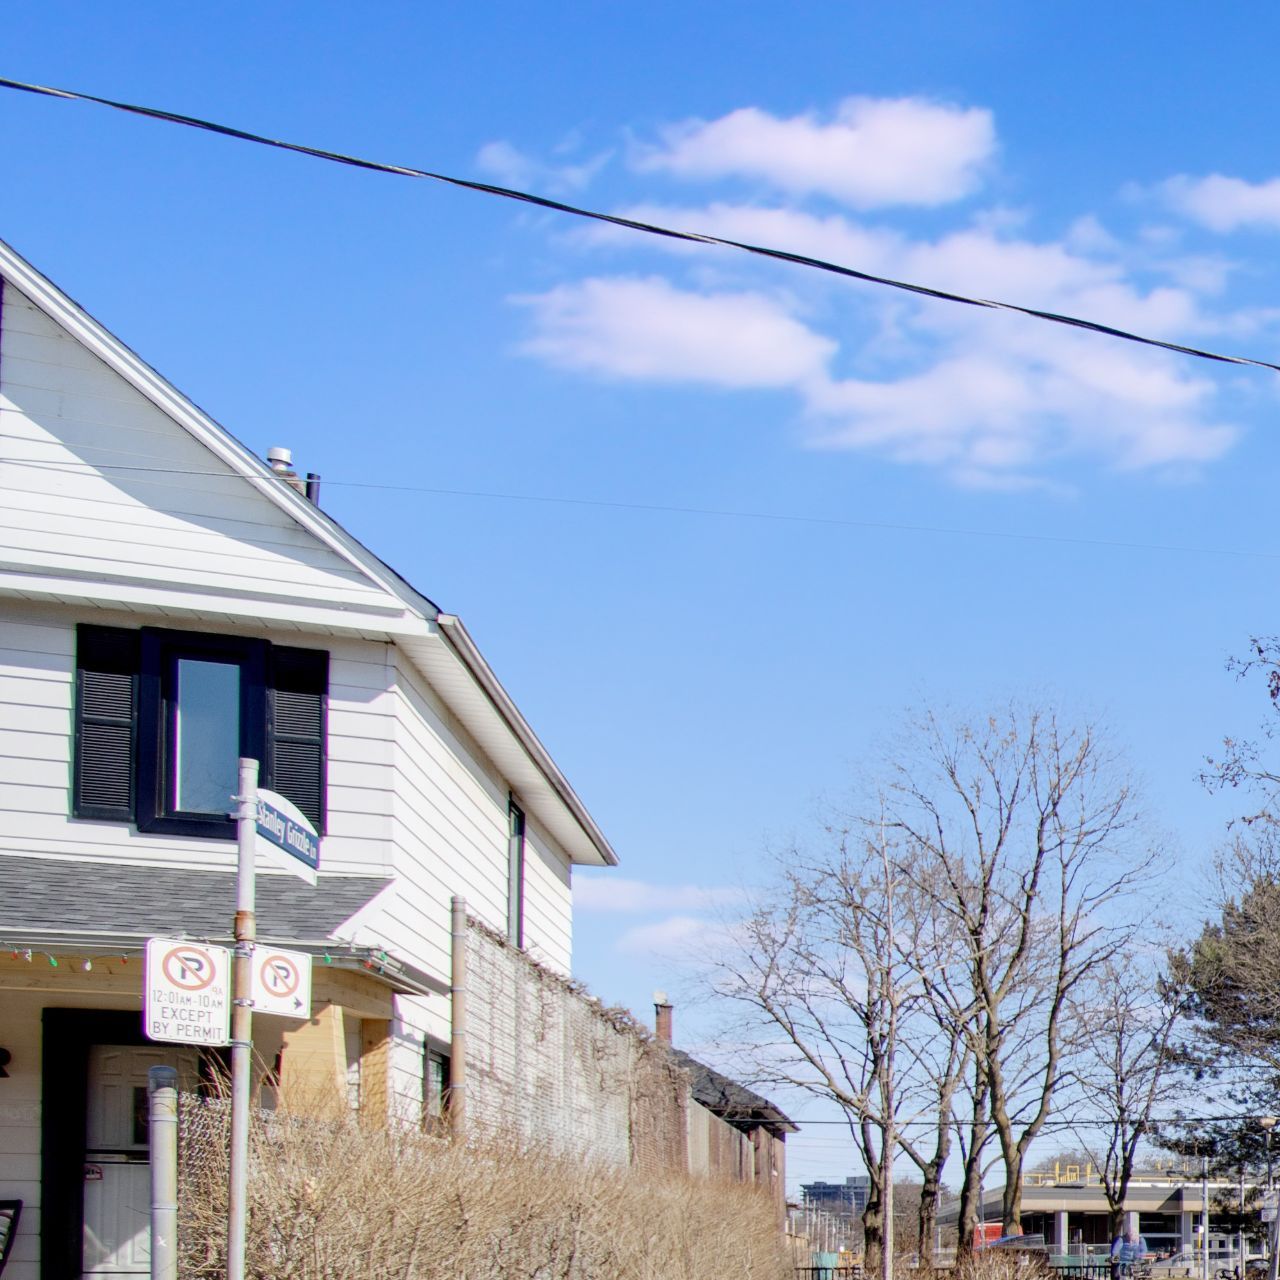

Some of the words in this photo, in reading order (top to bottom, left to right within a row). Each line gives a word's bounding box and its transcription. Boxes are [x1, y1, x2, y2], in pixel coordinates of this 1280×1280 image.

[258, 802, 285, 844] Stanley
[287, 820, 310, 856] Grizzle
[161, 1006, 213, 1023] EXCEPT
[153, 1021, 169, 1034] BY
[177, 1023, 223, 1040] PERMIT
